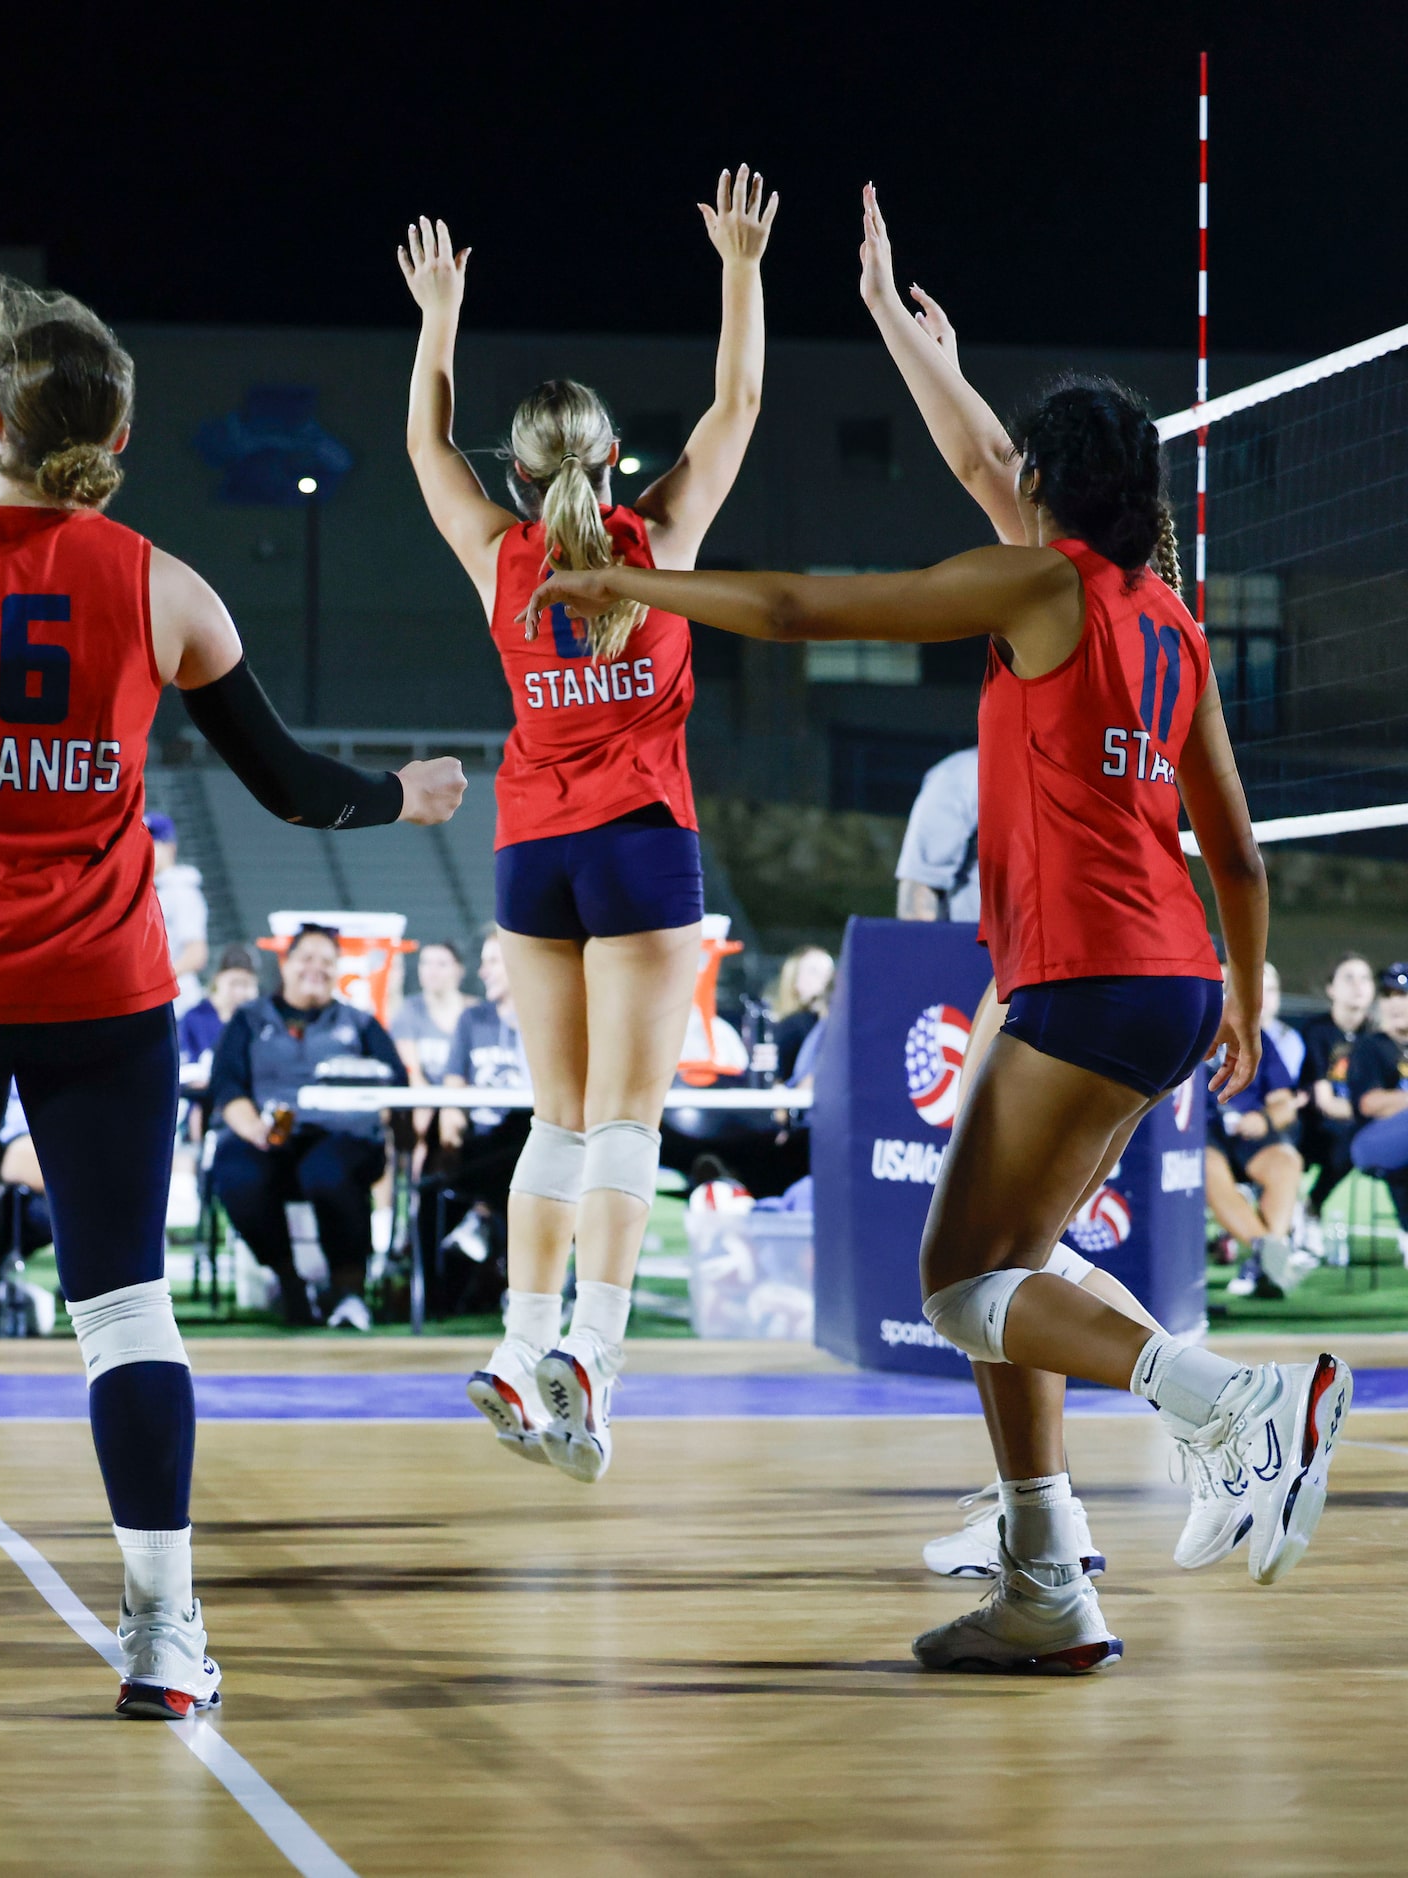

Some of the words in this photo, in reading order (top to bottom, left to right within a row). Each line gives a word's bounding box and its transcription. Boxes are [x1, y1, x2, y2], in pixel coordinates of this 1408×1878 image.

[525, 657, 656, 709] STANGS
[1138, 612, 1181, 744] 11
[1102, 727, 1176, 784] STA
